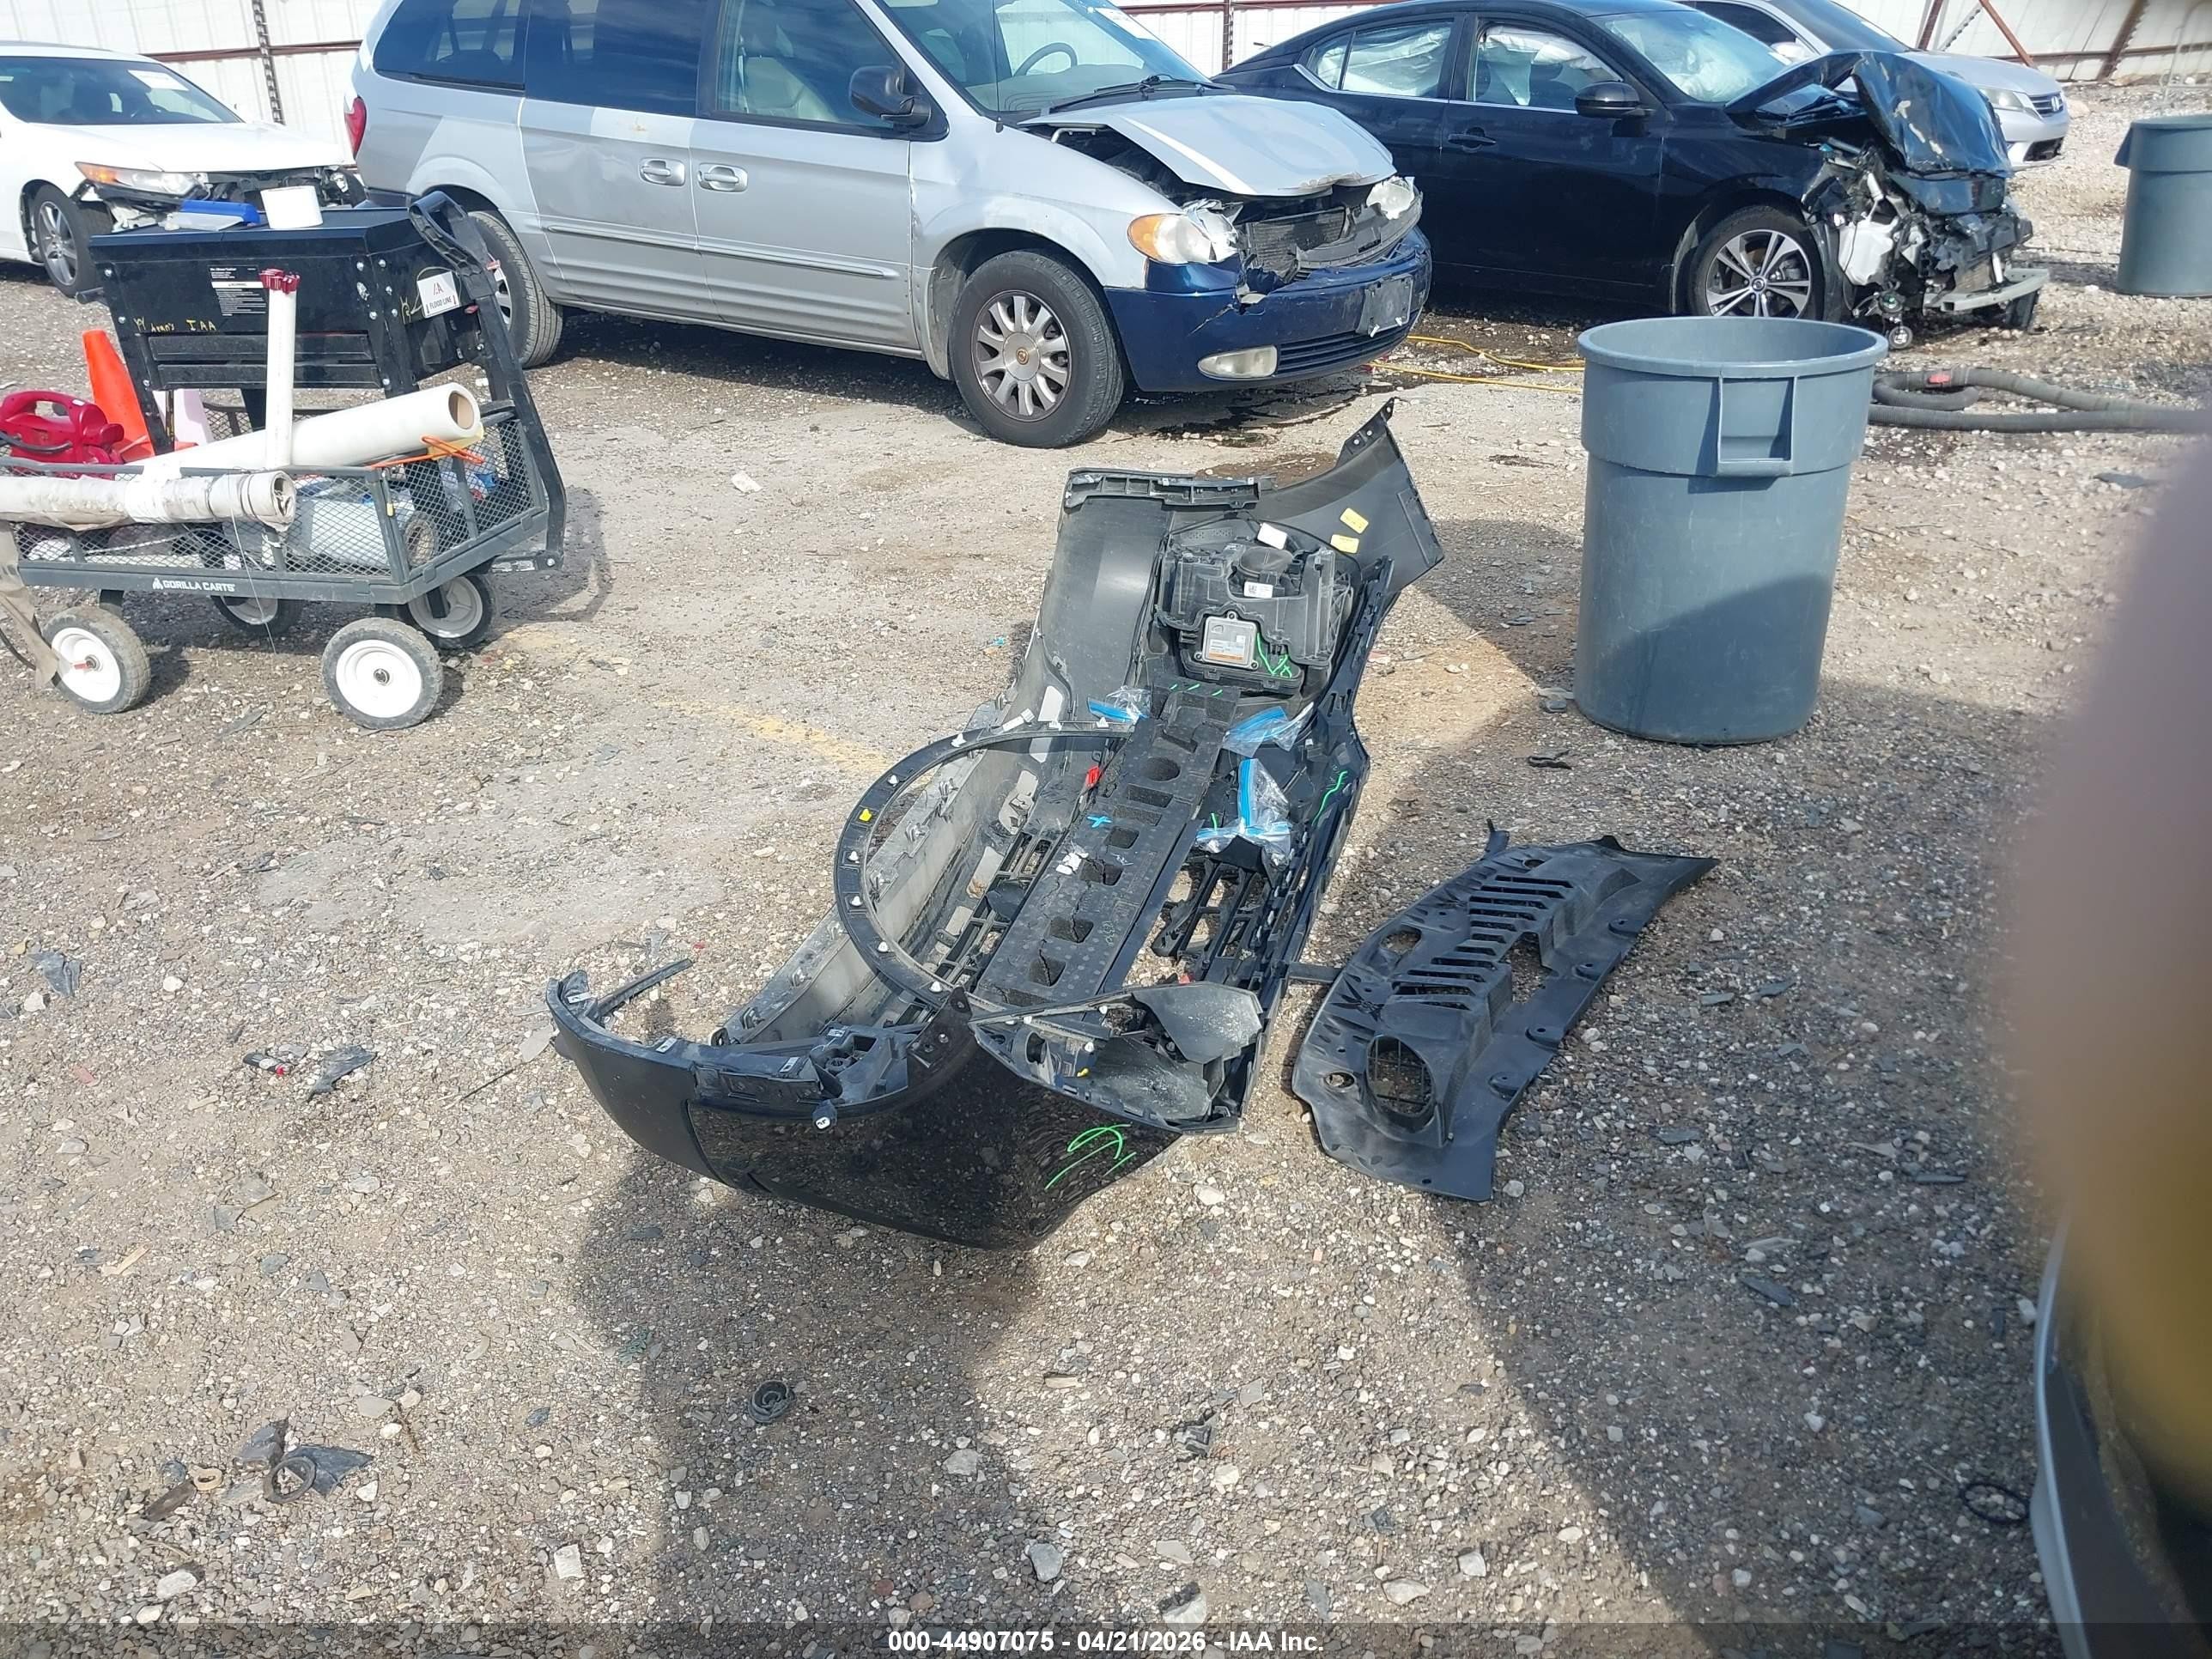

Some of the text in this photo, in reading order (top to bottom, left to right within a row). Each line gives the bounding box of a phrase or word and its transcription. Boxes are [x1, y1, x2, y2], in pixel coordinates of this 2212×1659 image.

[429, 295, 453, 310] FLOOD LINE
[162, 580, 203, 591] GORILLA
